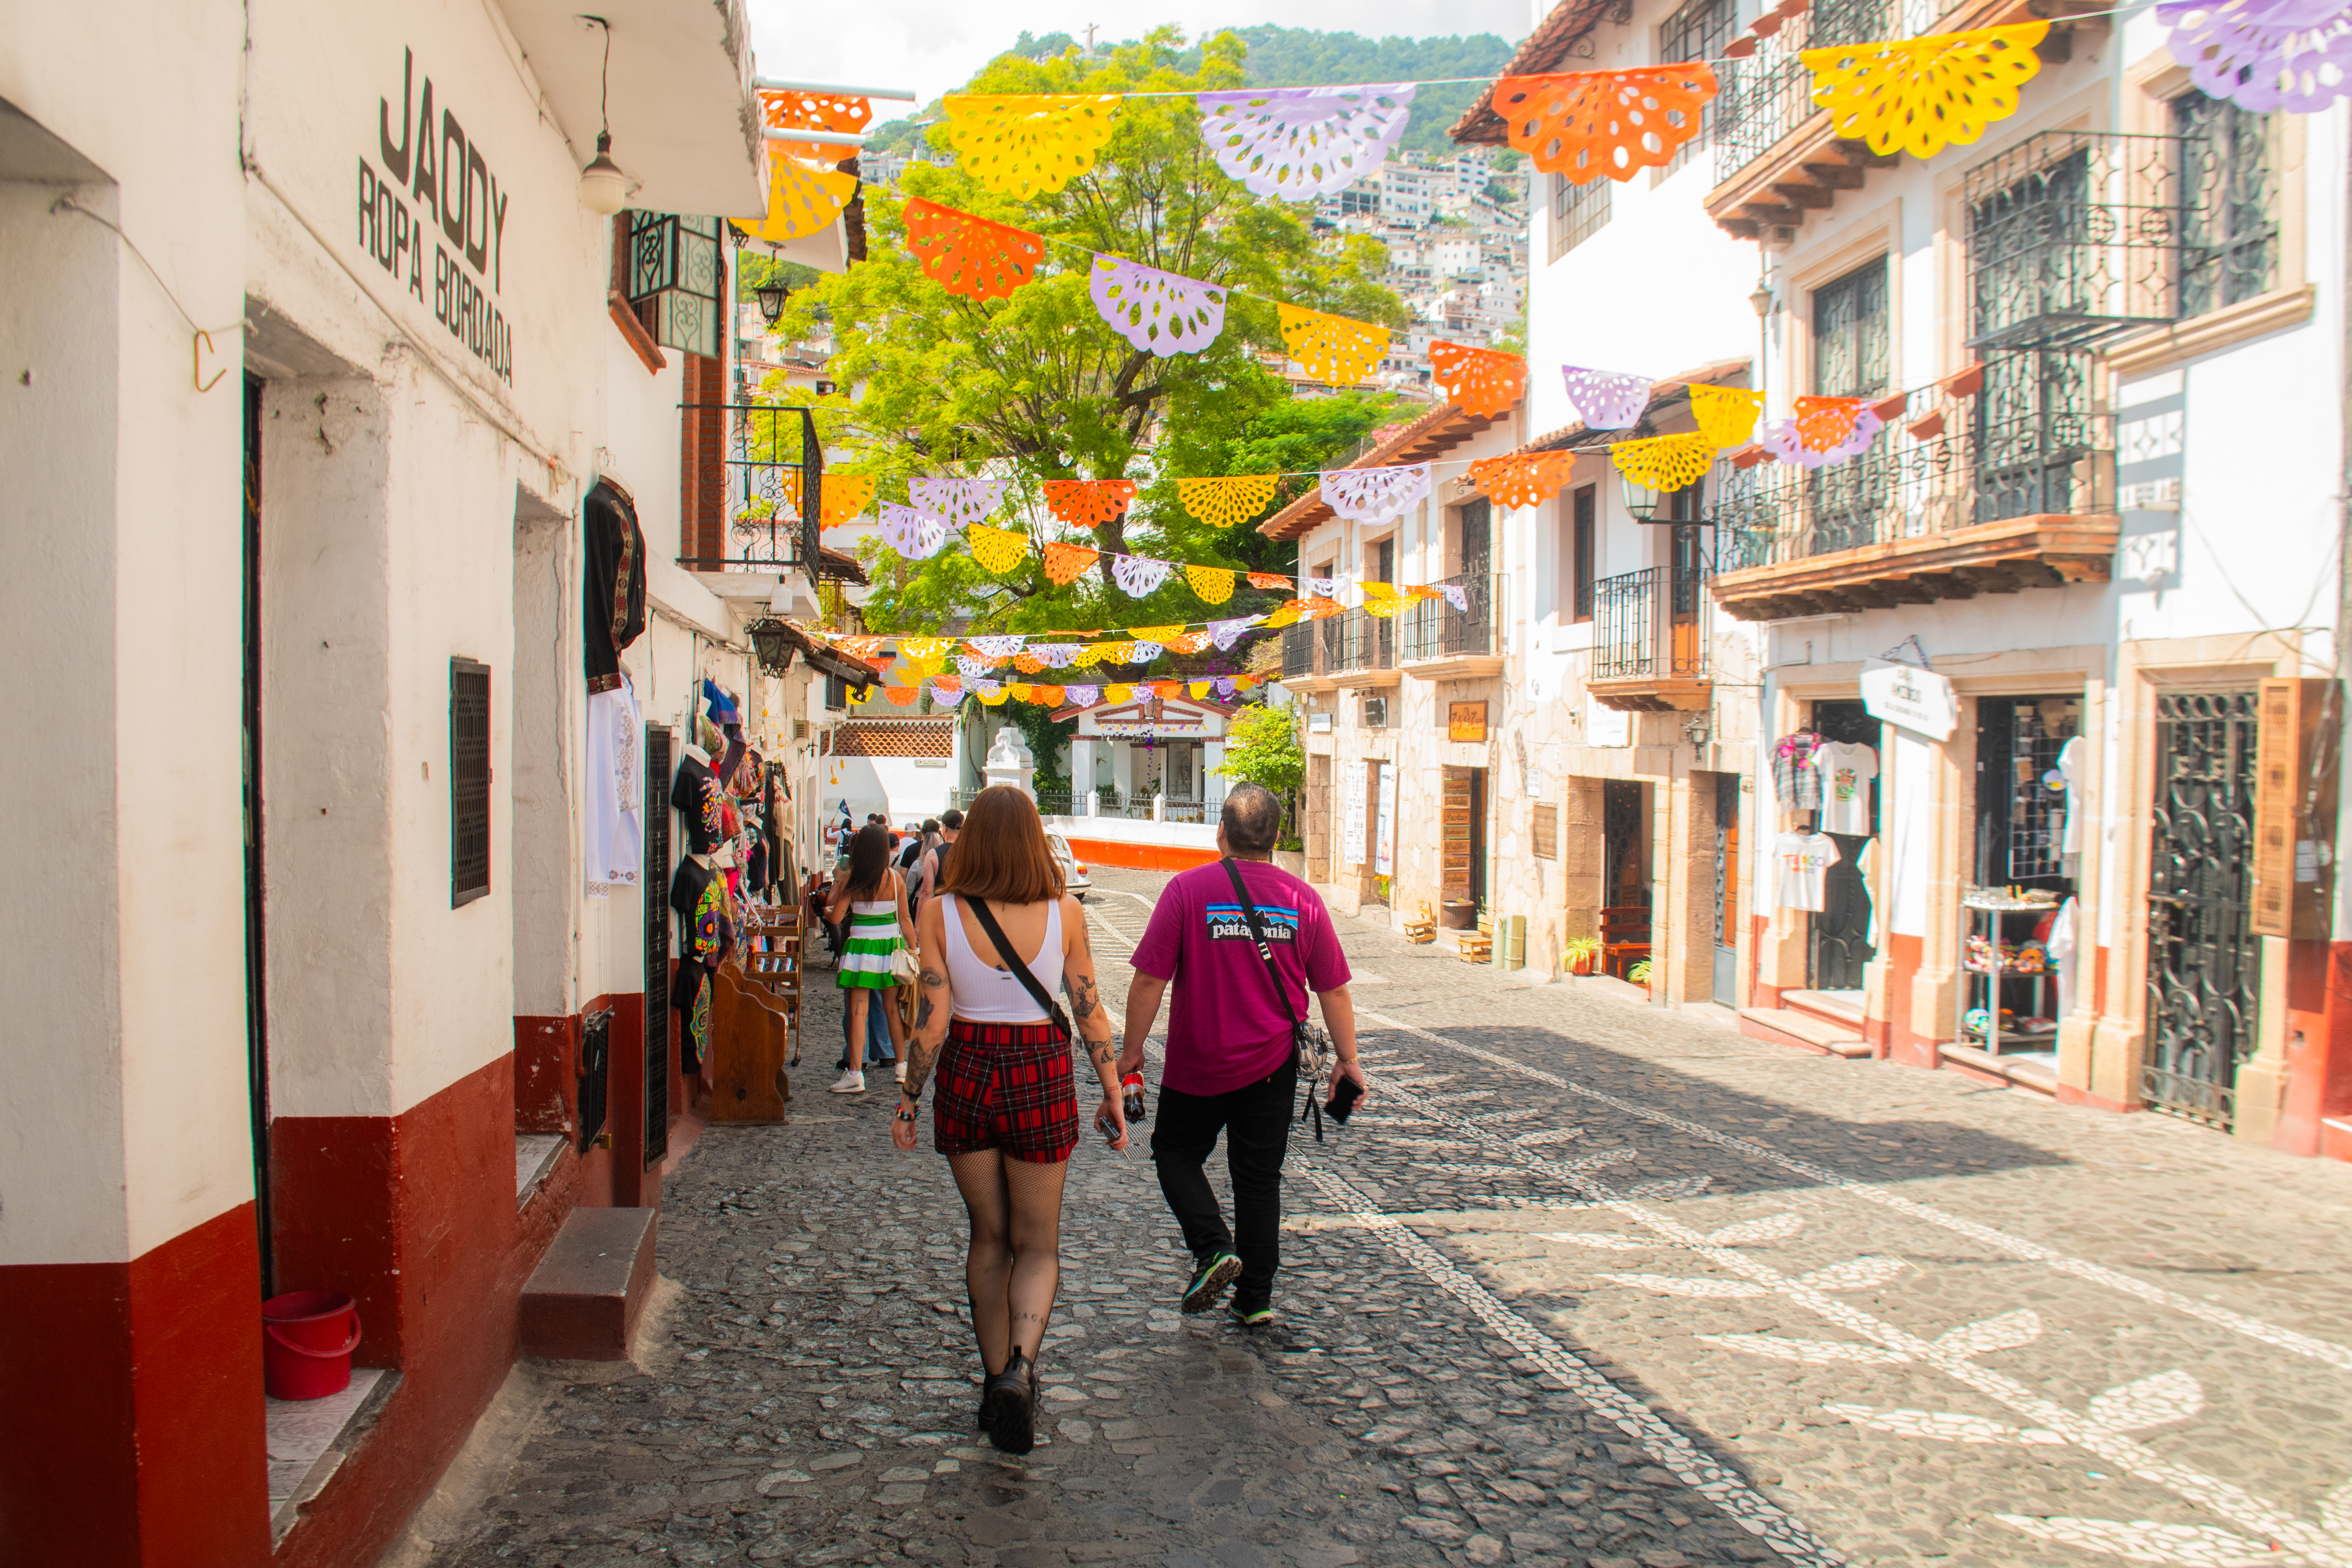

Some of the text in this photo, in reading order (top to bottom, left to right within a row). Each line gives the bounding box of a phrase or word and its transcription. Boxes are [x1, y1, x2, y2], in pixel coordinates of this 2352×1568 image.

[359, 155, 513, 389] ROPA BORDADA
[380, 44, 508, 296] JAODY
[1445, 813, 1467, 822] Pastas
